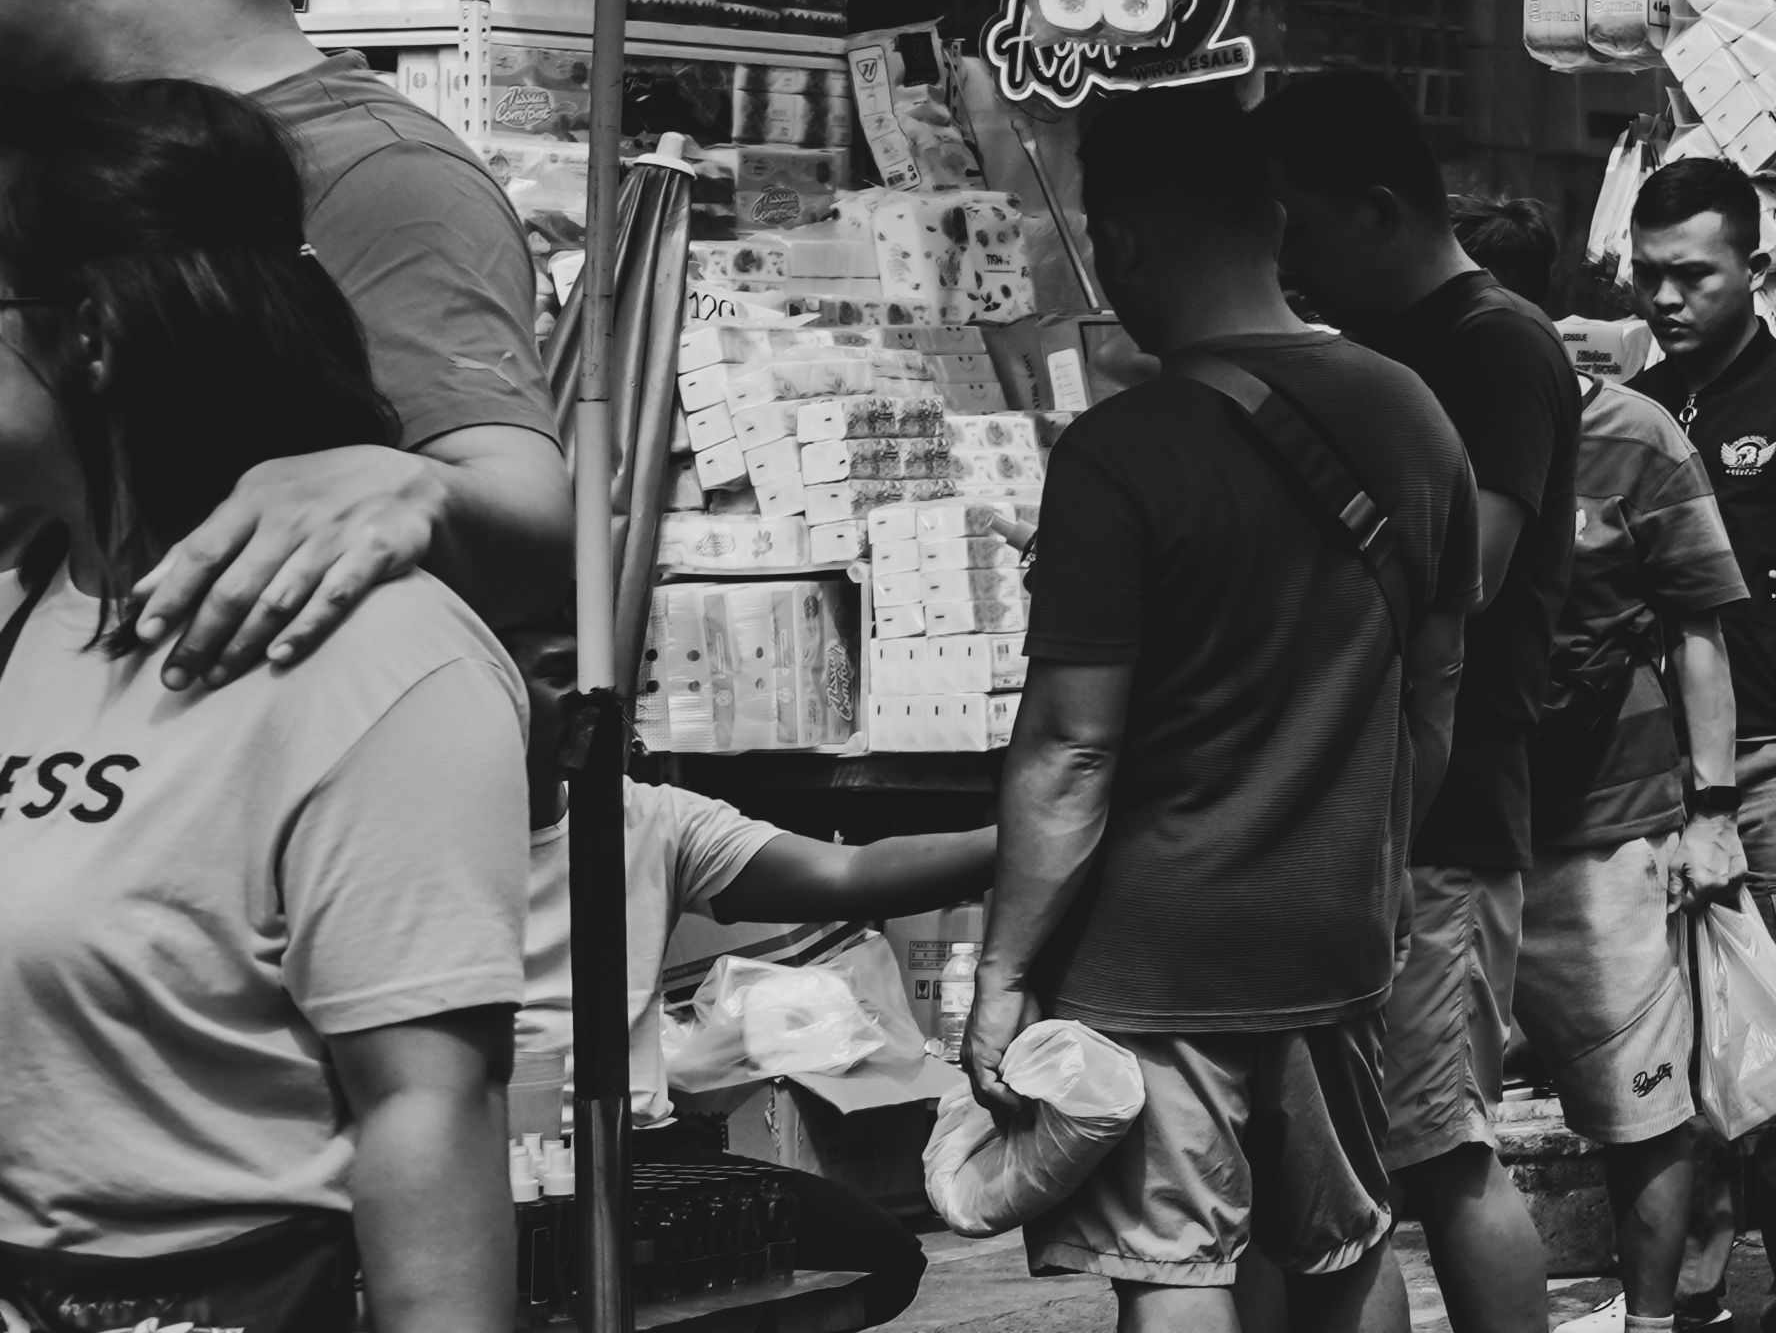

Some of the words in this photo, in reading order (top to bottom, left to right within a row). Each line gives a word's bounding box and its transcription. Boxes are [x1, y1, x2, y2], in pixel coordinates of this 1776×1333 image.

[1132, 48, 1244, 81] WHOLESALE
[504, 85, 552, 107] Tissue
[494, 102, 553, 127] Comfort
